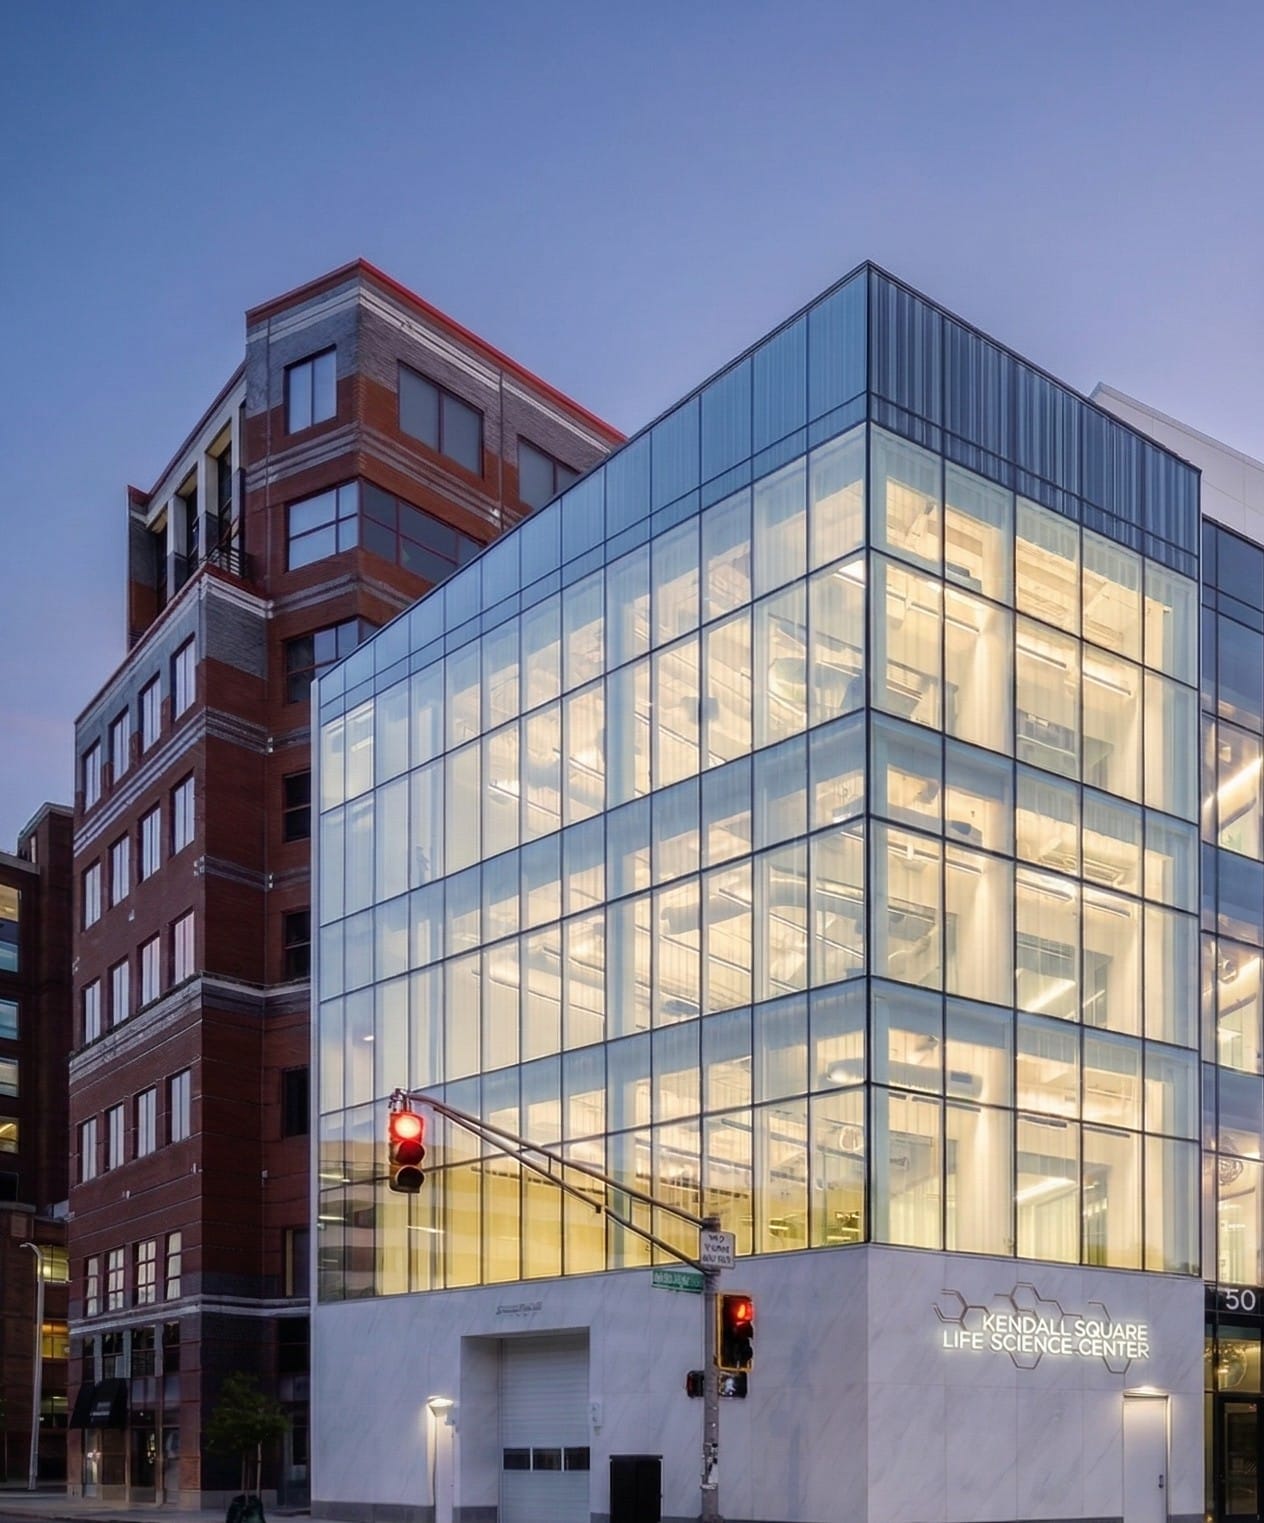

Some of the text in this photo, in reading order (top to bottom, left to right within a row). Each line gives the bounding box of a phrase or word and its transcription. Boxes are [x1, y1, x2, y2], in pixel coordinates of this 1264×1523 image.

[1225, 1288, 1256, 1311] 50
[982, 1314, 1149, 1341] KENDALL SQUARE
[943, 1330, 1150, 1359] LIFE SCIENCE CENTER
